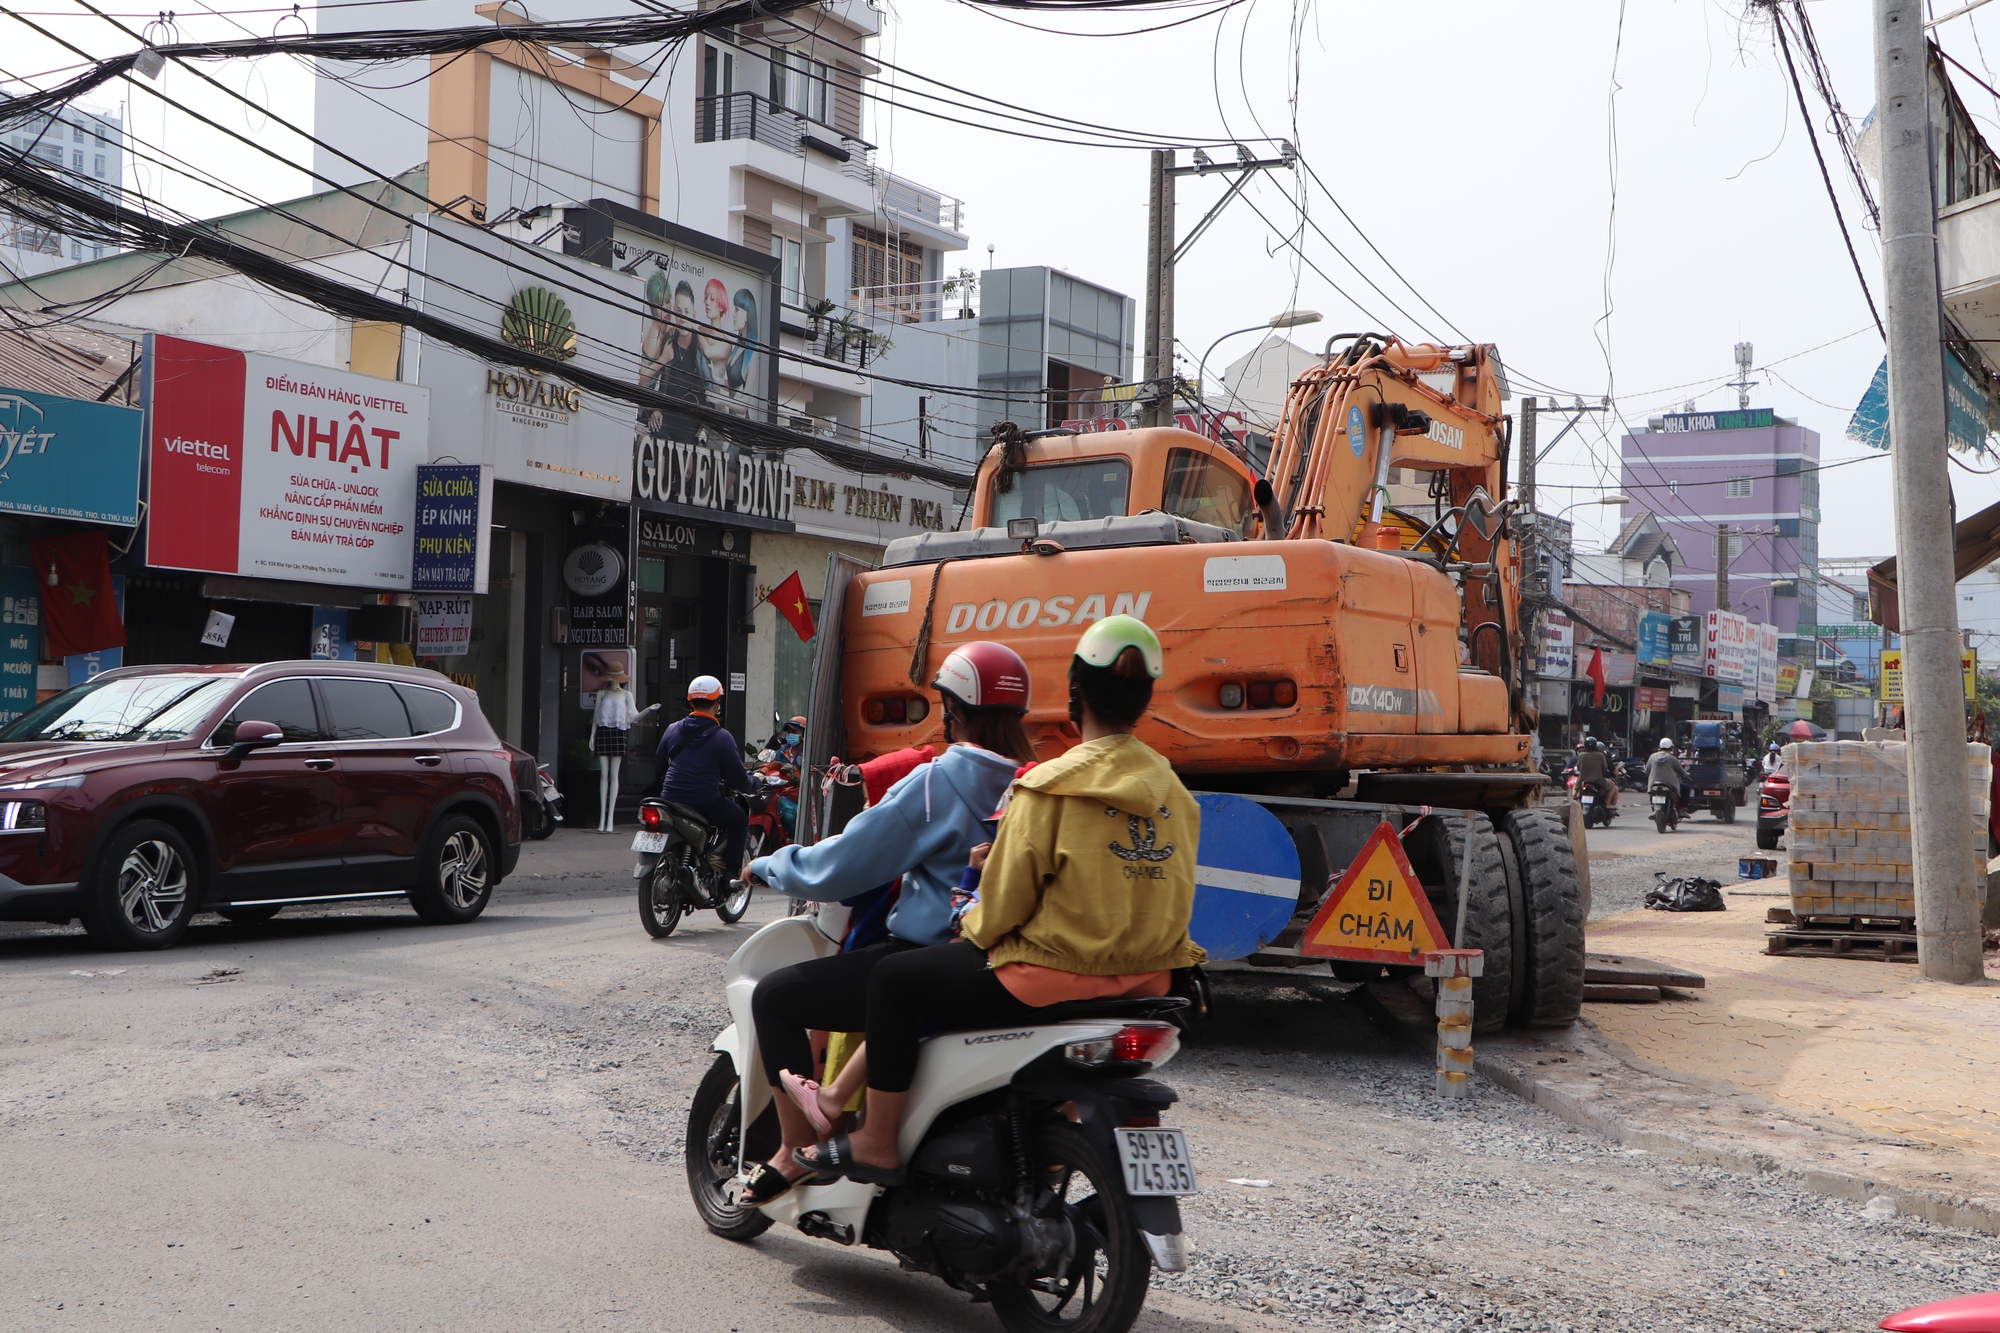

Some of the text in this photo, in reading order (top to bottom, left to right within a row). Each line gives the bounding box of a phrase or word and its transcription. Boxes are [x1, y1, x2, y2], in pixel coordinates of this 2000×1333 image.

[681, 261, 705, 278] shine!
[266, 374, 408, 414] ĐIỂM BÁN HÀNG VIETTEL
[486, 369, 581, 412] HOYANG
[1688, 415, 1716, 431] KHOA
[164, 436, 231, 461] viettel
[271, 410, 401, 474] NHẬT
[196, 462, 230, 476] telecom
[290, 473, 309, 488] SỬA
[311, 478, 336, 492] CHỮA
[344, 483, 379, 498] UNLOCK
[423, 475, 473, 497] SỬA CHỮA
[285, 491, 383, 515] NÂNG CẤP PHẦN MỀM
[793, 475, 944, 531] KIM THIÊN NGA
[259, 504, 404, 536] KHẲNG ĐỊNH SỰ CHUYÊN NGHIỆP
[422, 504, 472, 525] ÉP KÍNH
[291, 528, 375, 549] BÁN MÁY TRẢ GÓP
[642, 521, 696, 545] SALON
[420, 533, 472, 558] PHỤ KIỆN
[418, 563, 430, 581] BÁN
[431, 563, 445, 581] MÁY
[457, 563, 470, 582] GÓP
[574, 575, 606, 585] HOYANG
[419, 597, 471, 618] NẠP-RÚT
[573, 605, 623, 619] HAIR SALON
[945, 591, 1152, 634] DOOSAN
[420, 618, 450, 643] CHUYỂN
[452, 618, 470, 642] TIỀN
[605, 624, 625, 643] BÌNH
[1678, 632, 1691, 642] TRÍ
[10, 634, 28, 650] MỖI
[1671, 643, 1698, 652] TAY GA
[3, 661, 32, 674] NGƯỜI
[3, 686, 29, 698] 1 MÁY
[1123, 865, 1167, 880] CHANEL
[1368, 878, 1392, 902] ĐI
[1339, 911, 1414, 944] CHẬM
[964, 1031, 1035, 1046] VISION
[1126, 1132, 1178, 1160] 59-X3
[1129, 1163, 1190, 1191] 745.35
